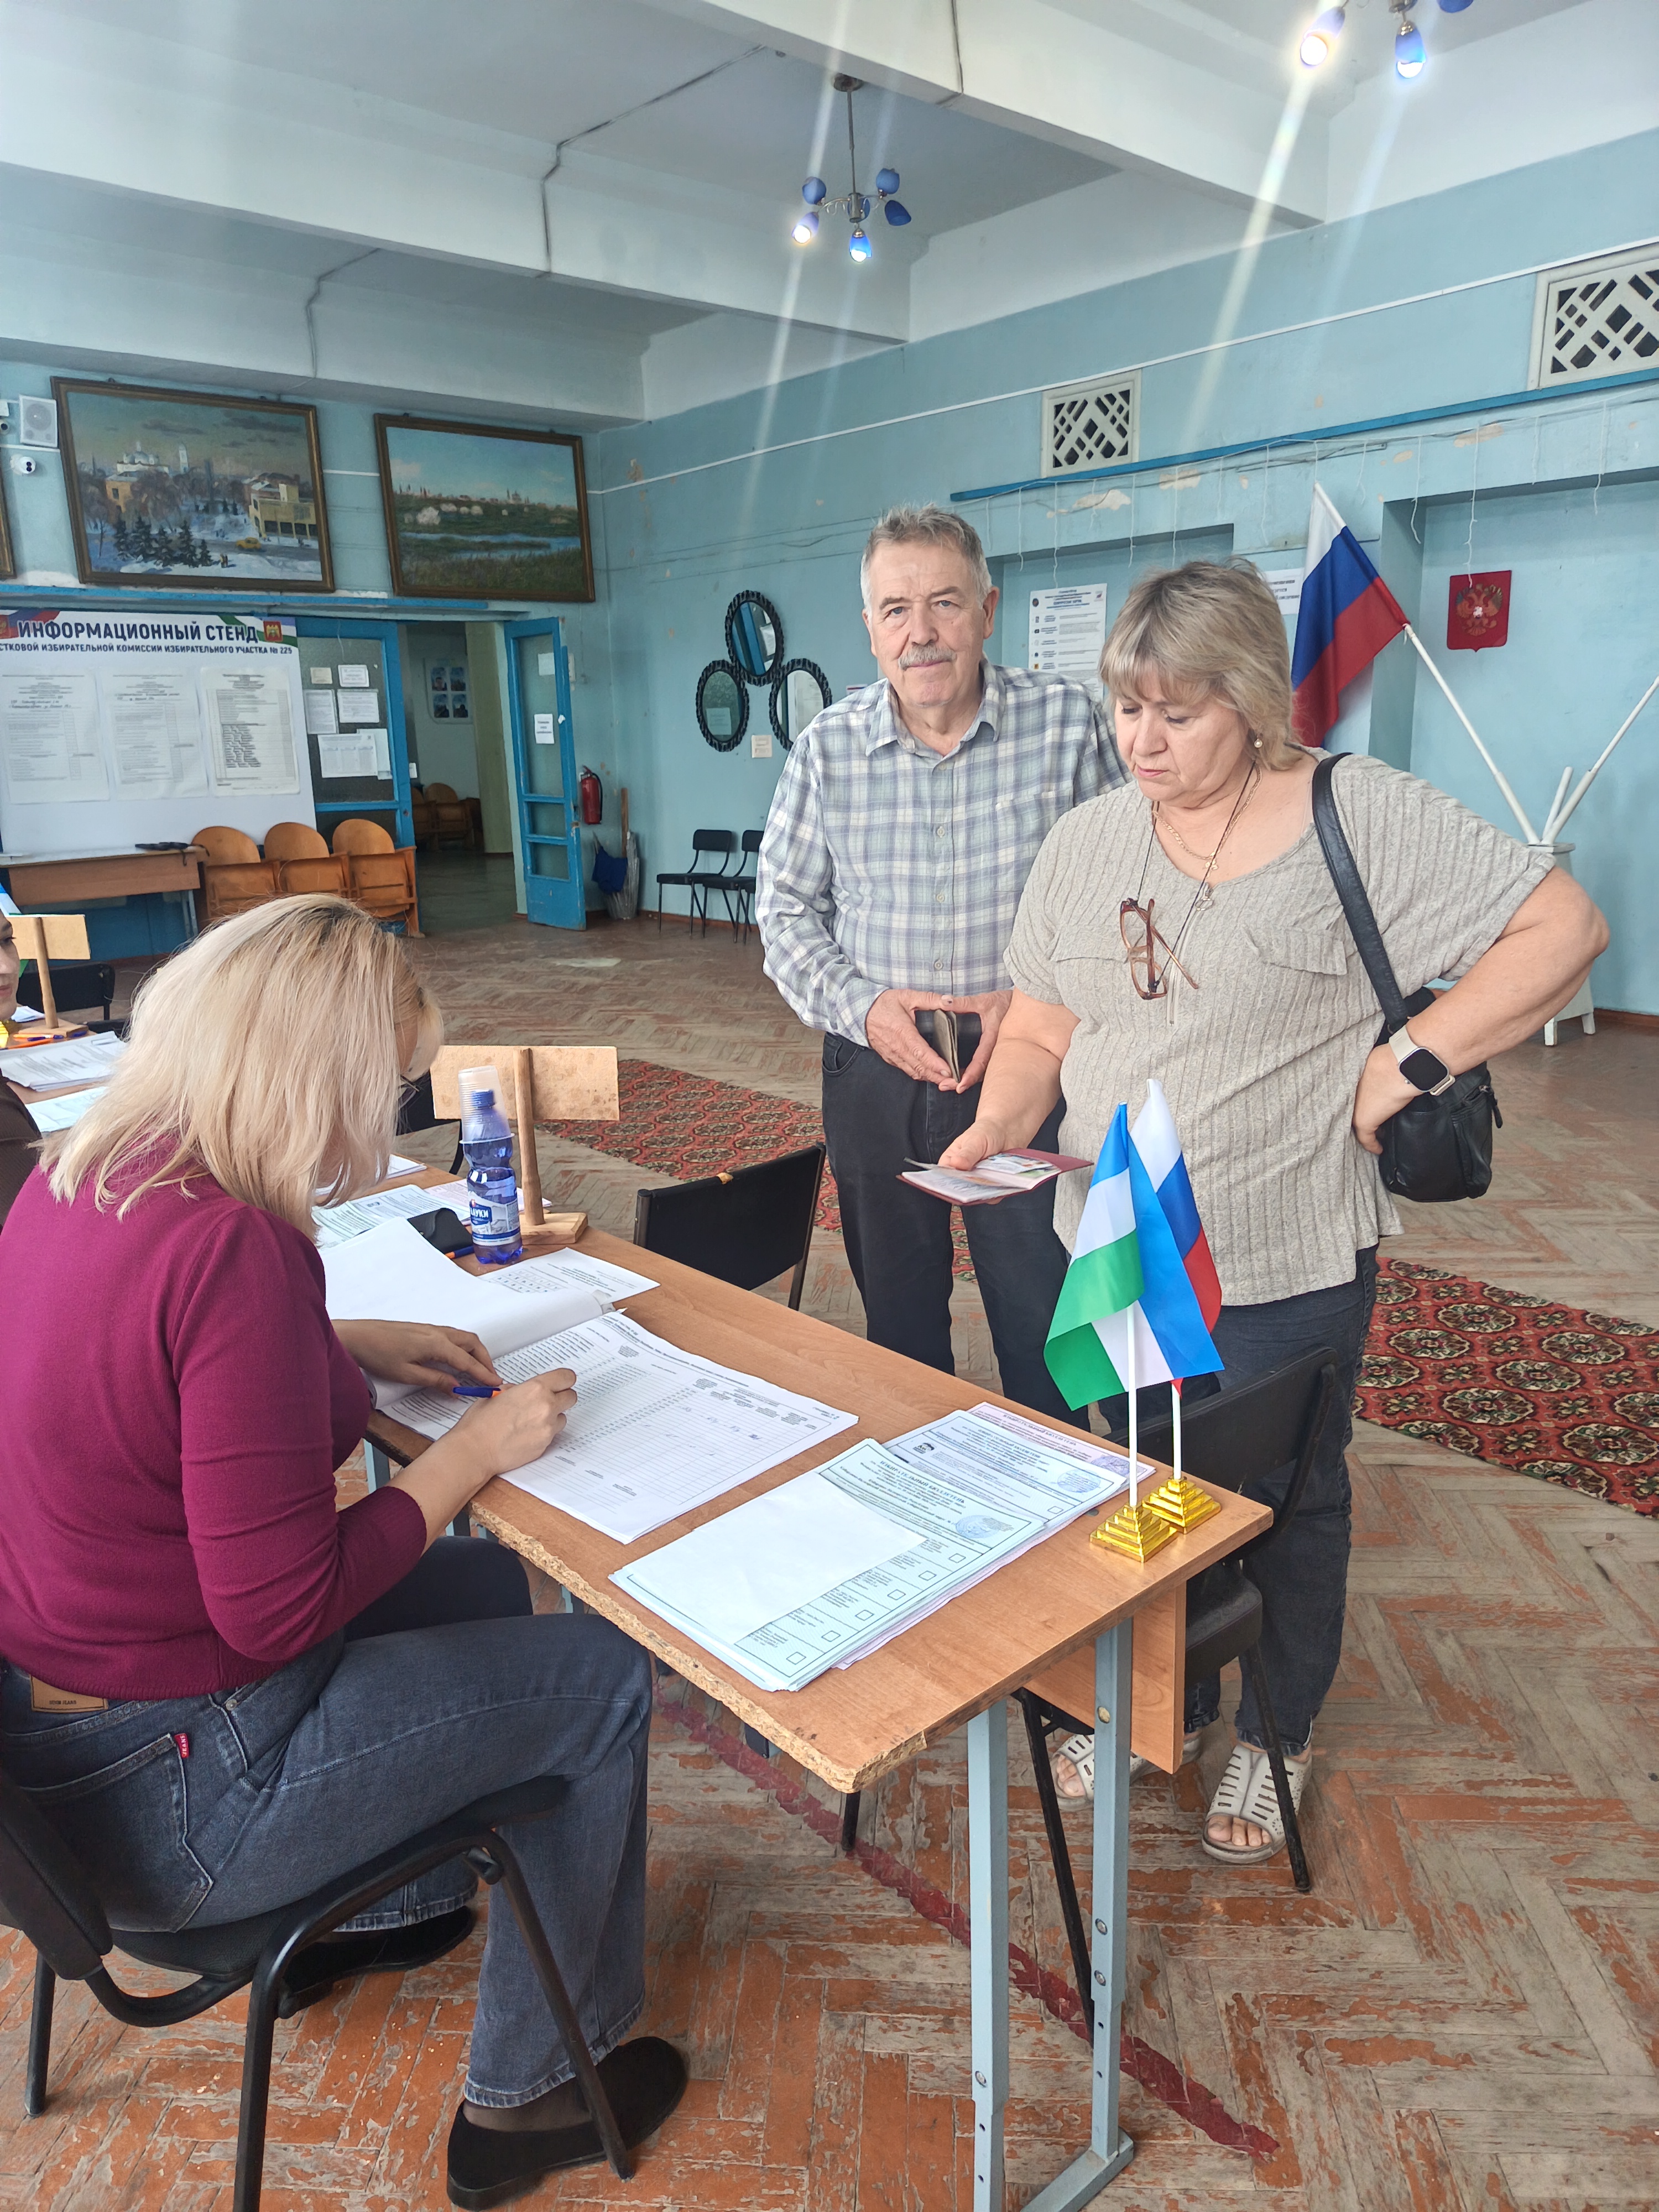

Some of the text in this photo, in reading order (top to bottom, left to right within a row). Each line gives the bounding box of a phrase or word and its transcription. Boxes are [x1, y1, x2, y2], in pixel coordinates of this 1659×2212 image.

[18, 620, 258, 643] ИНФОРМАЦИОННЫЙ СТЕНД
[41, 643, 114, 653] ИЗБИРАТЕЛЬНОЙ
[116, 644, 163, 653] КОМИССИИ
[164, 645, 234, 654] ИЗБИРАТЕЛЬНОГО
[236, 646, 268, 655] УЧАСТКА
[280, 646, 293, 655] 225
